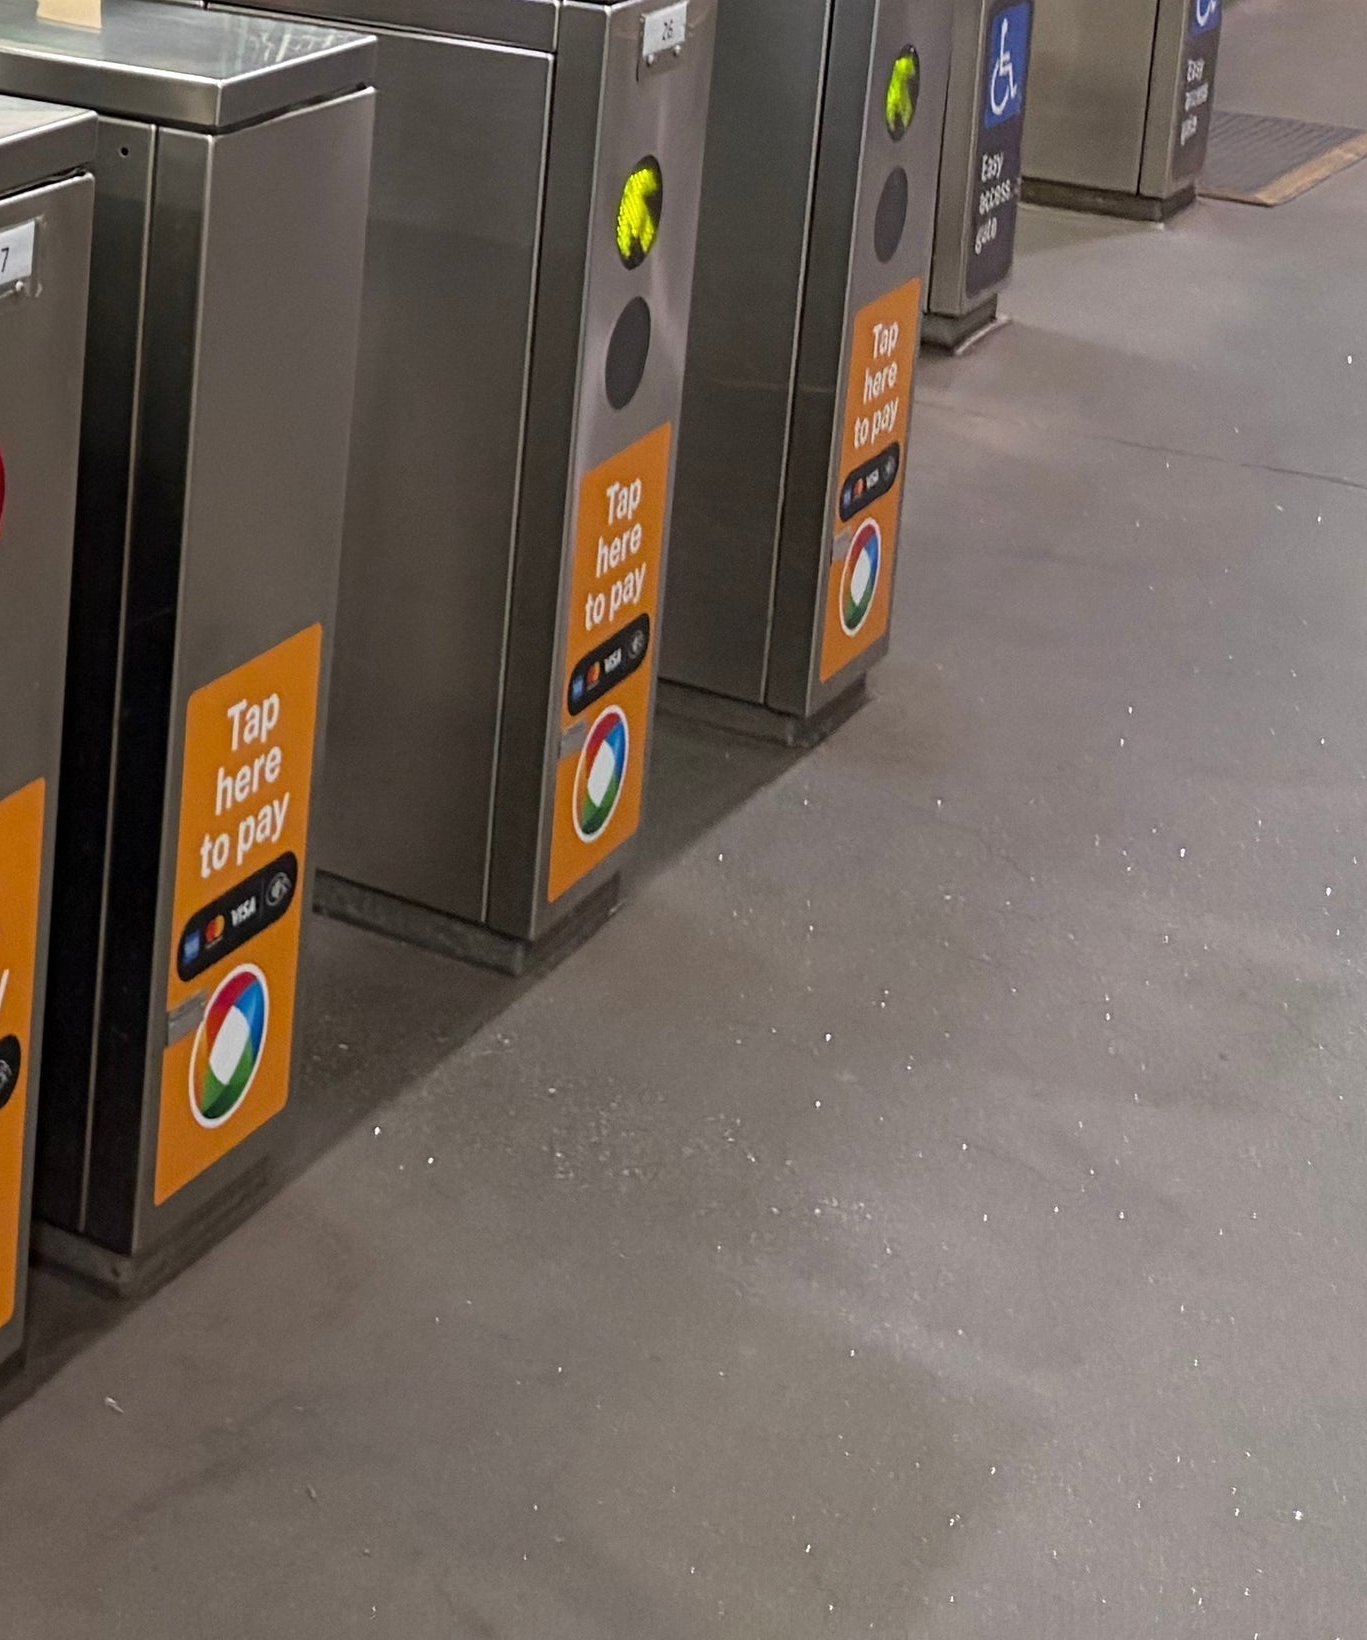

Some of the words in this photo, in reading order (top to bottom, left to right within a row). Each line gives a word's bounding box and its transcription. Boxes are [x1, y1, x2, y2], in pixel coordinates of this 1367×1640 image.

[981, 151, 1004, 183] Easy
[873, 321, 899, 360] Tap
[863, 361, 897, 405] here
[853, 415, 868, 450] to
[871, 398, 899, 445] pay
[607, 477, 641, 525] Tap
[595, 522, 642, 579] here
[585, 590, 606, 631] to
[609, 562, 647, 622] pay
[227, 691, 280, 752] Tap
[215, 746, 282, 817] here
[200, 833, 229, 879] to
[237, 792, 290, 866] pay
[231, 896, 256, 927] VISA
